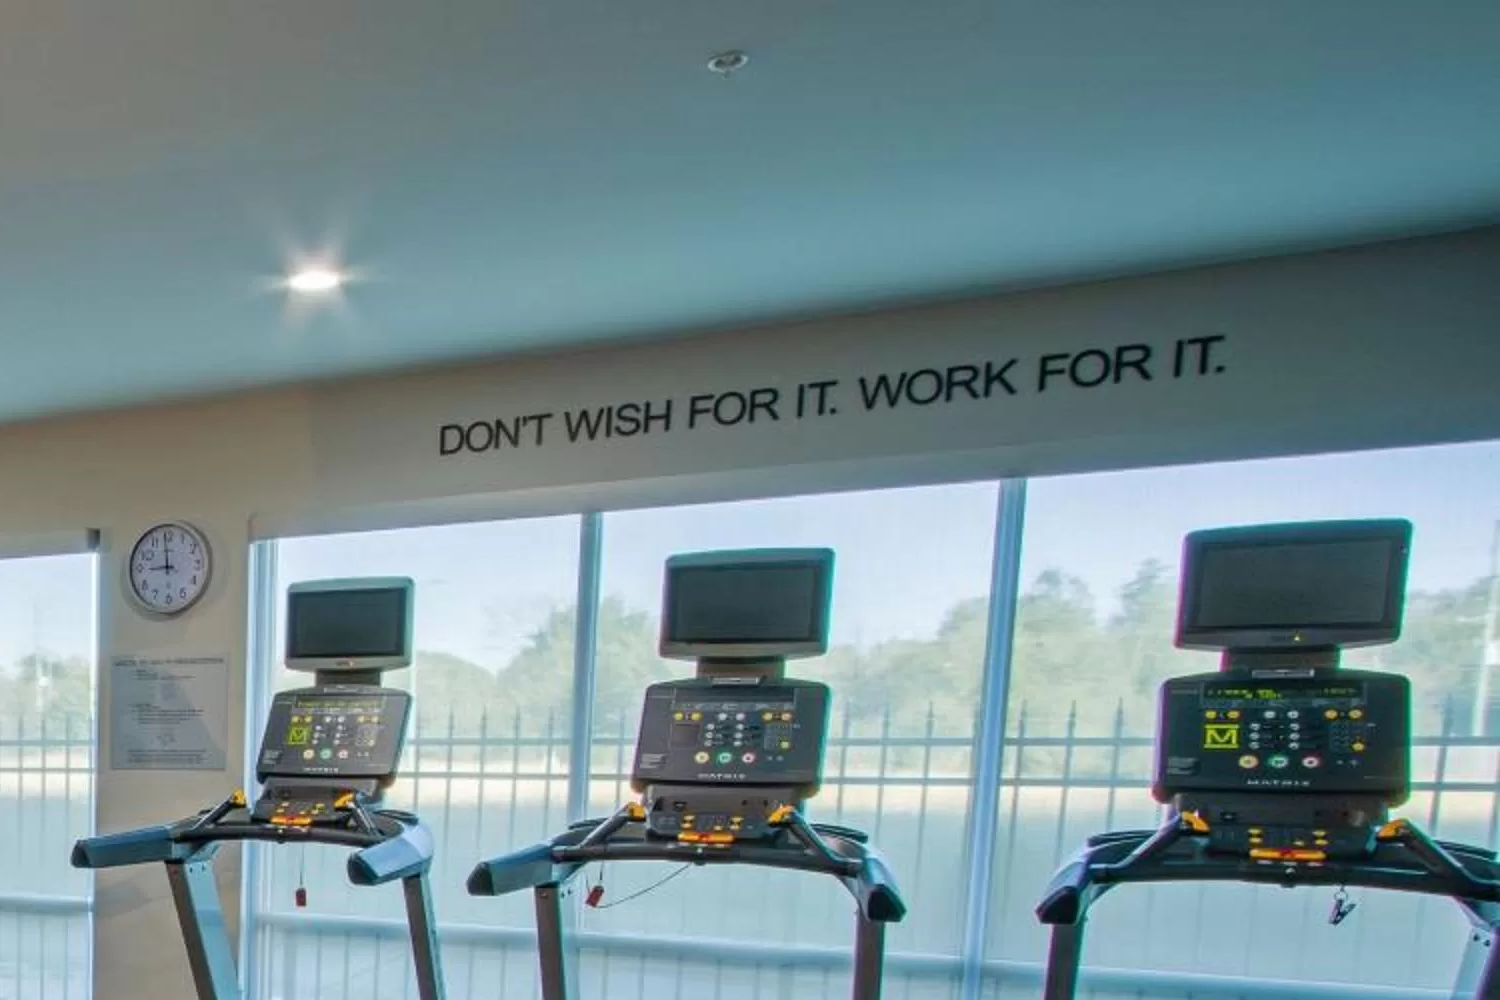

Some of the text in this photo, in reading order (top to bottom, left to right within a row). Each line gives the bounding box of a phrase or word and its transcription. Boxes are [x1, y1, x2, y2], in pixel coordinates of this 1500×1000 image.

[438, 334, 1226, 456] DON'T WISH FOR IT. WORK FOR IT.
